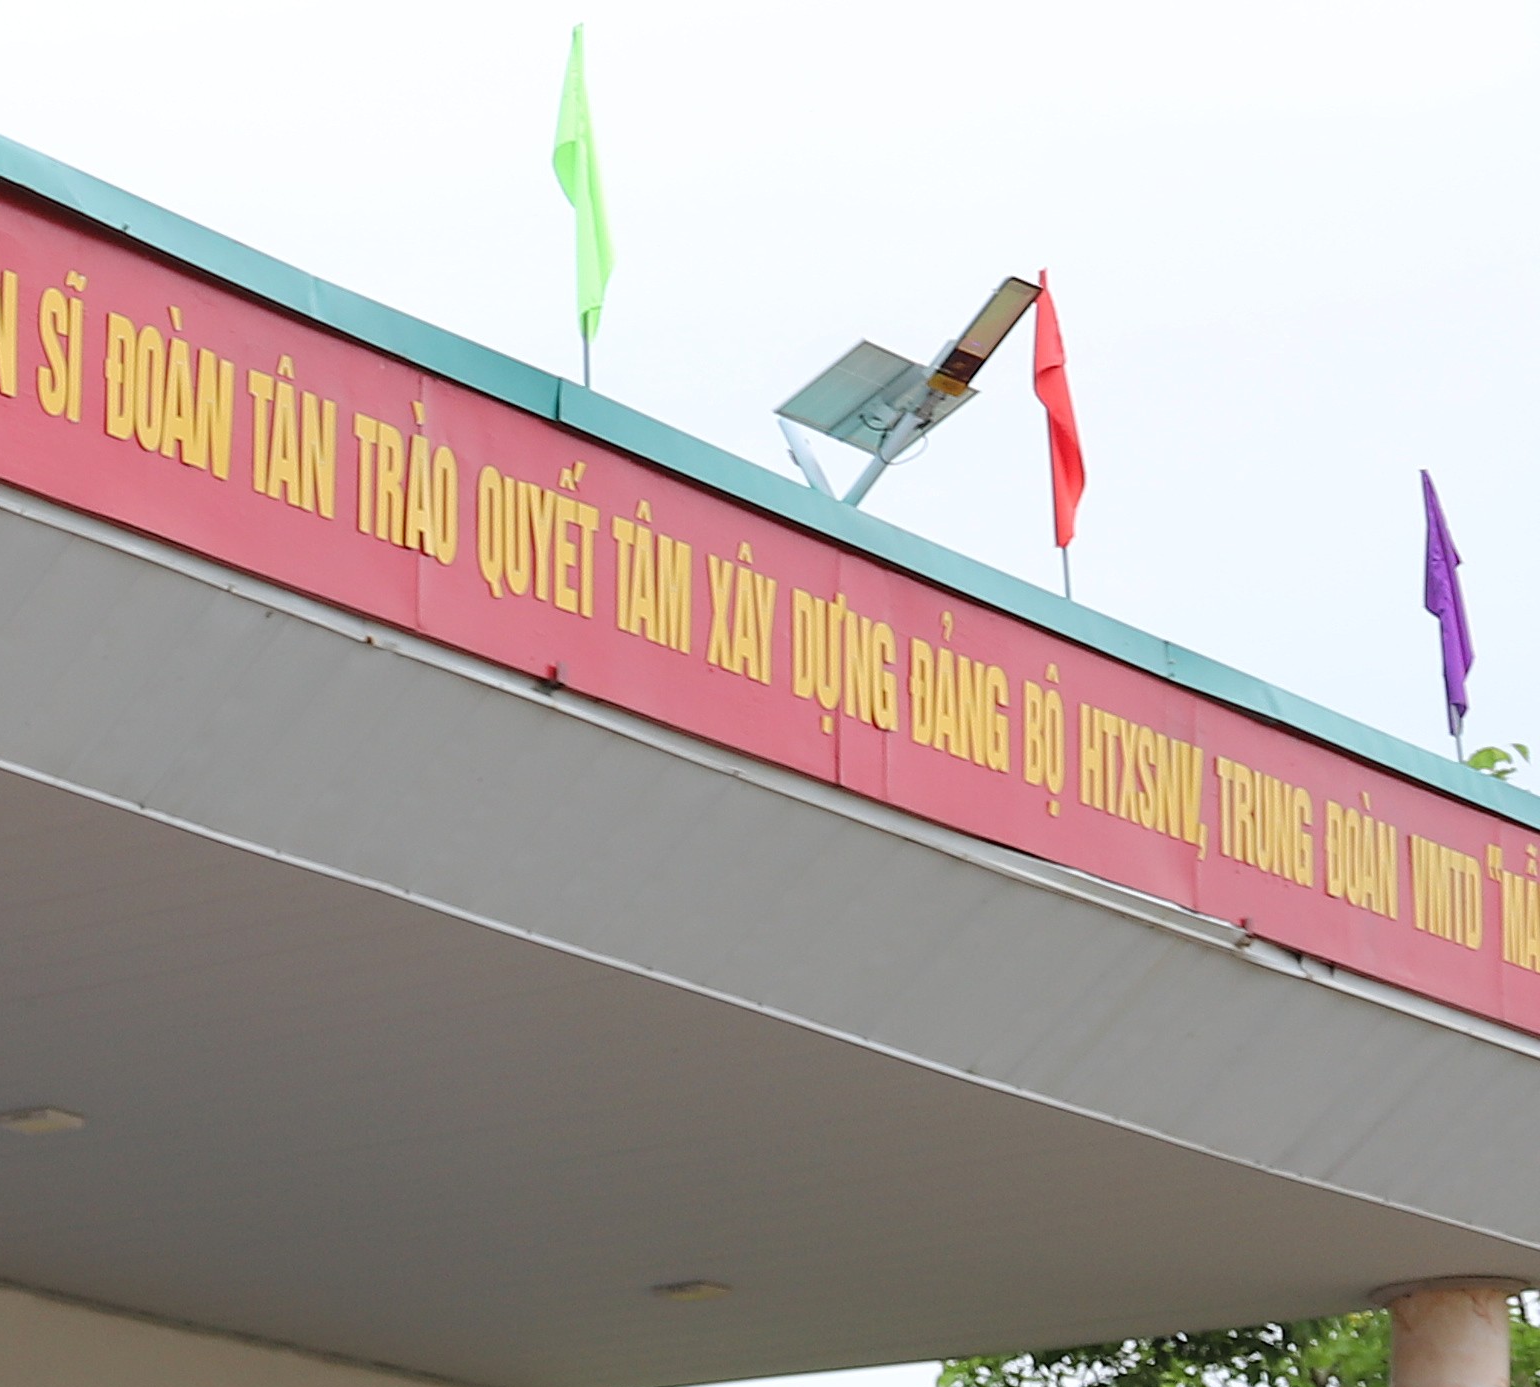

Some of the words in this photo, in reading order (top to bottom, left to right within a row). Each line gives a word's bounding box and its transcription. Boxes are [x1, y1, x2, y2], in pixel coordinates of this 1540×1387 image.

[38, 271, 87, 422] SĨ
[105, 306, 235, 480] ĐOÀN
[249, 355, 337, 518] TÂN
[354, 401, 459, 565] TRÀO
[478, 461, 600, 618] QUYẾT
[612, 501, 693, 654] TÂM
[707, 543, 777, 685] XÂY
[792, 588, 898, 734] DỰNG
[910, 611, 1010, 773] ĐẢNG
[1023, 665, 1065, 816] BỘ
[1079, 703, 1208, 860] HTXSNV,
[1217, 757, 1314, 886] TRUNG
[1325, 792, 1398, 920] ĐOÀN
